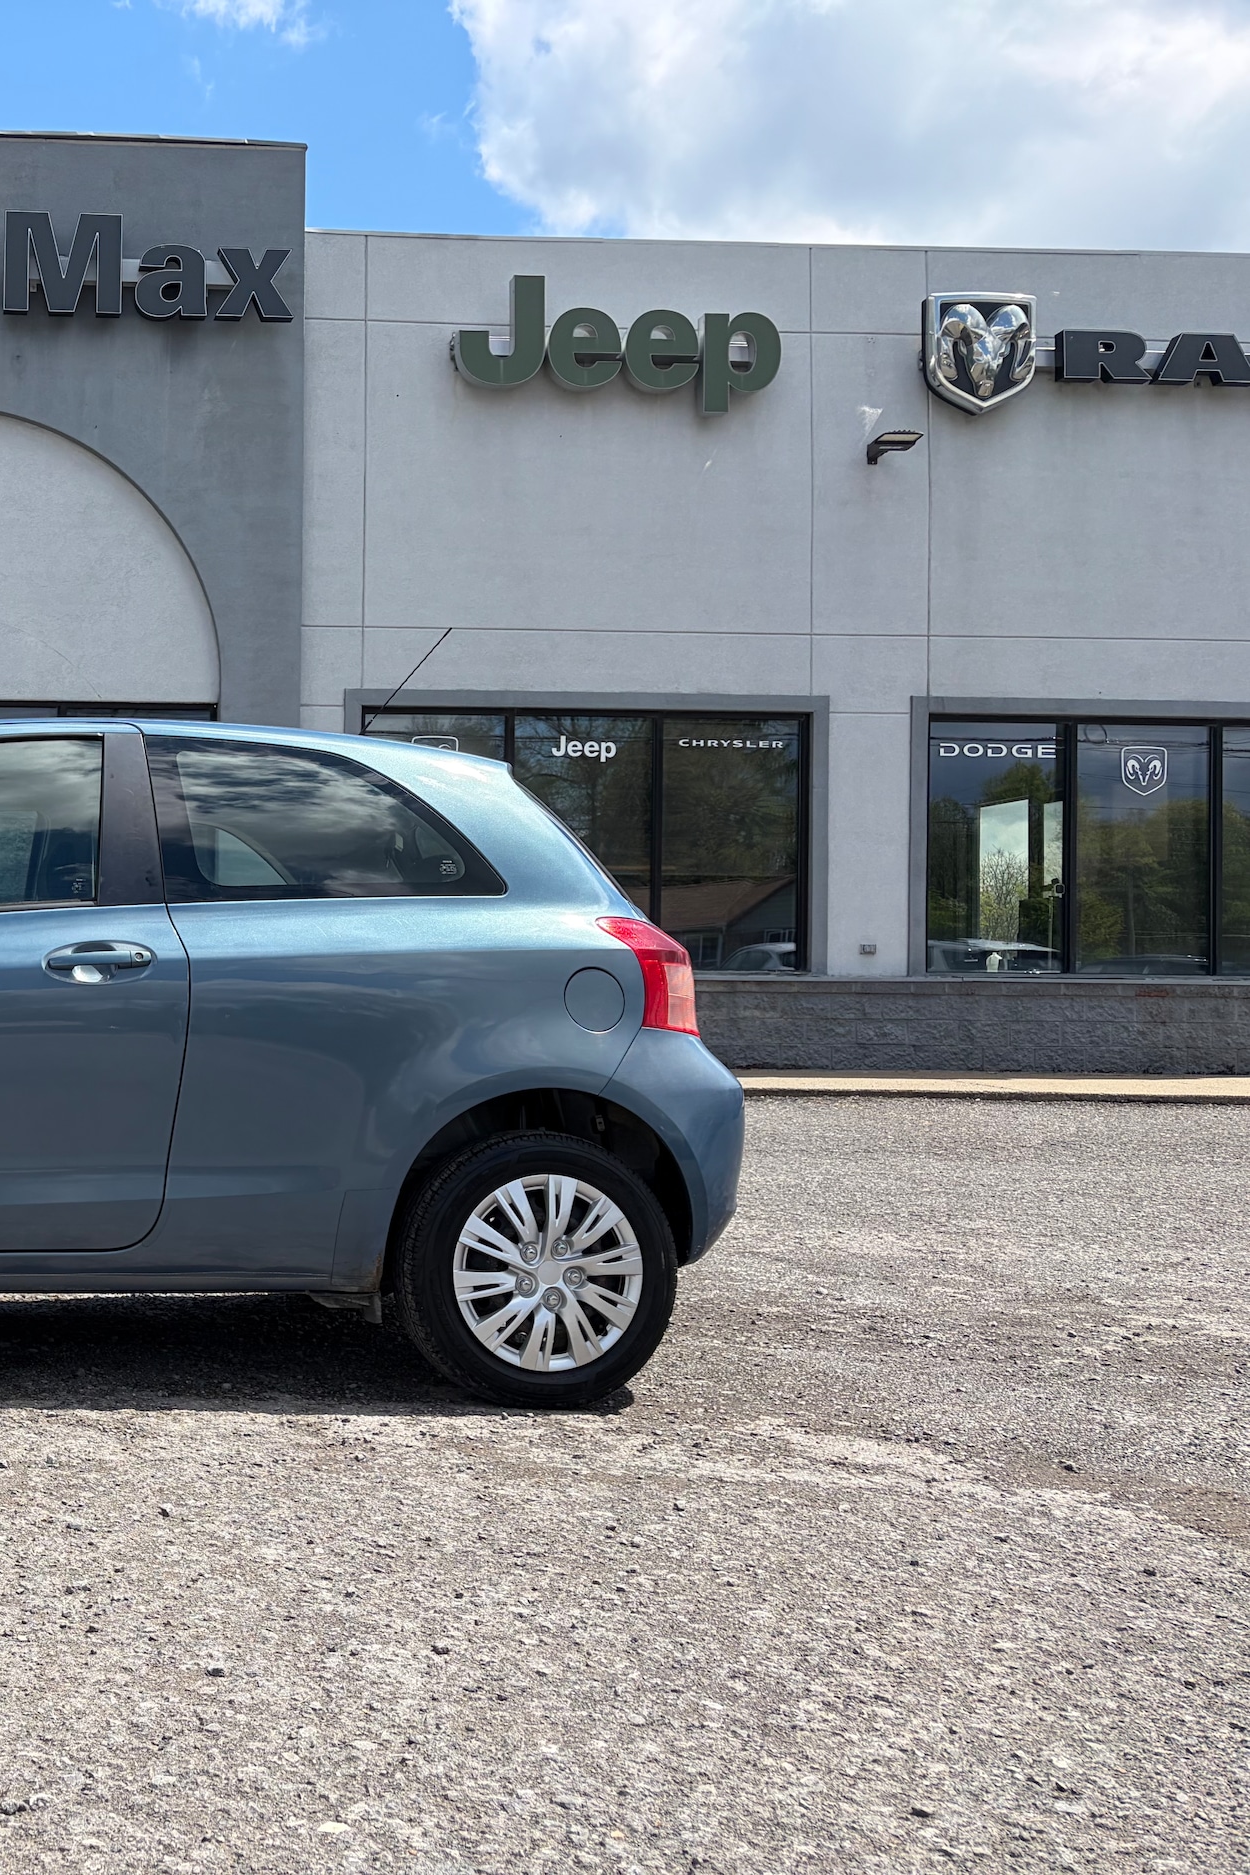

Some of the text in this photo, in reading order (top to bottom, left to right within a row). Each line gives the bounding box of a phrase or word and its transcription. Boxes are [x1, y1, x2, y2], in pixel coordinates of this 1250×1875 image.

[3, 210, 294, 322] Max
[454, 274, 782, 414] Jeep
[551, 735, 617, 762] Jeep
[678, 738, 784, 749] CHRYSLER
[939, 743, 1057, 759] DODGE
